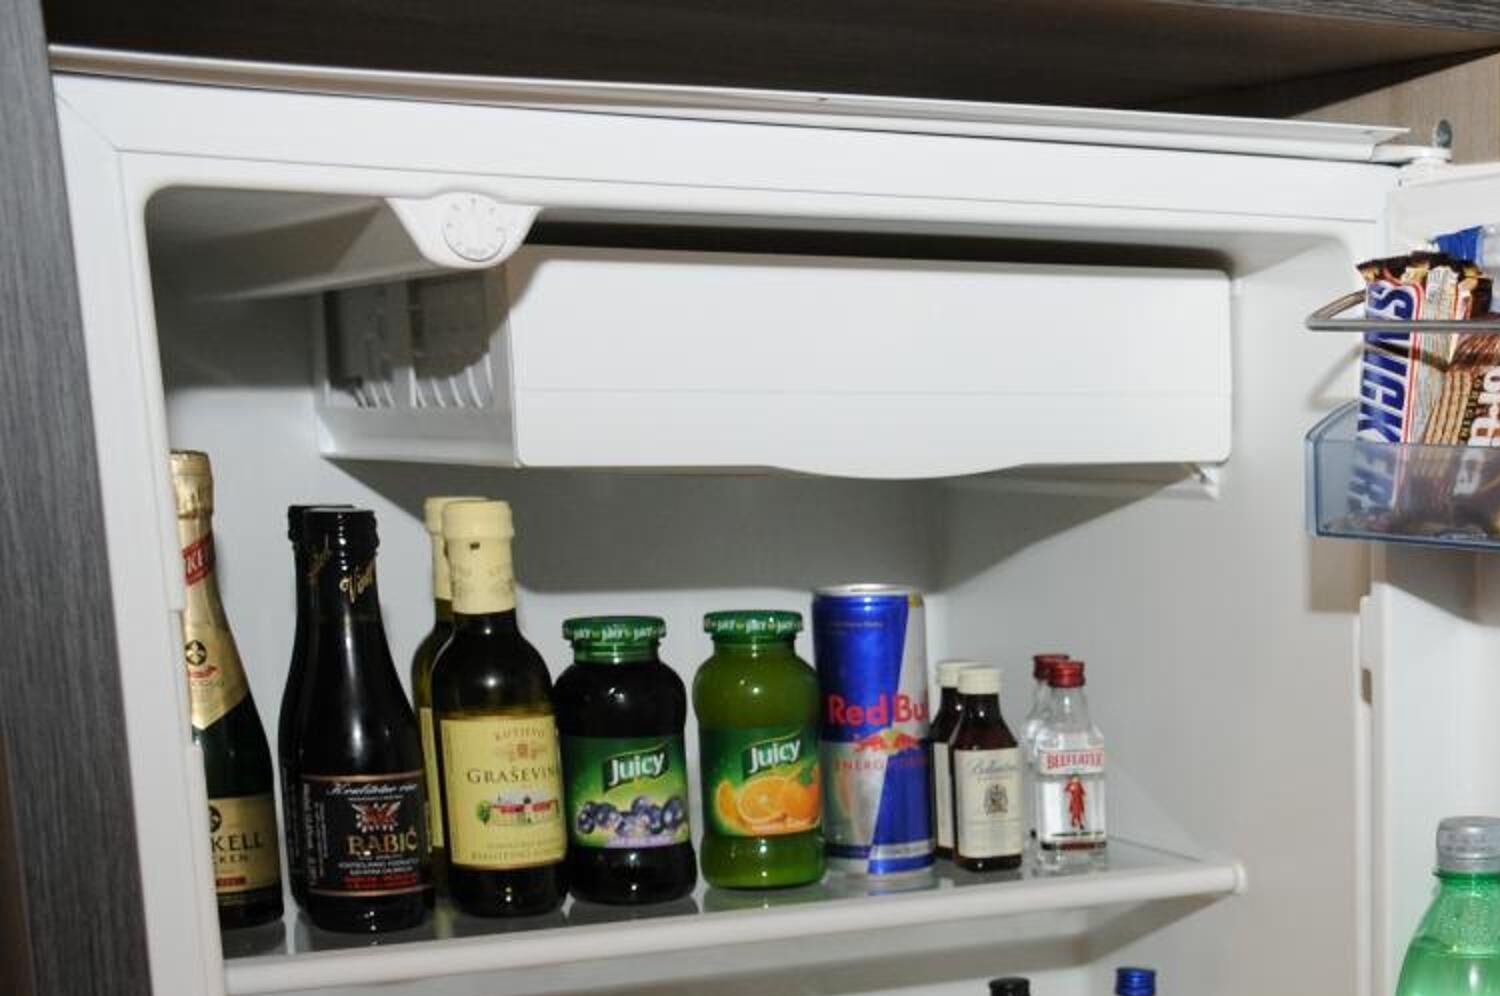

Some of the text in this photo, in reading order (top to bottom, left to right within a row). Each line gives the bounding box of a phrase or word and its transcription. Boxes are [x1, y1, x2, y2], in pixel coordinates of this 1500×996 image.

[829, 690, 928, 726] Red Bu
[608, 751, 665, 787] Juicy
[749, 739, 801, 774] Juicy
[467, 765, 558, 784] GRAŠEVIN
[210, 831, 264, 852] KELL
